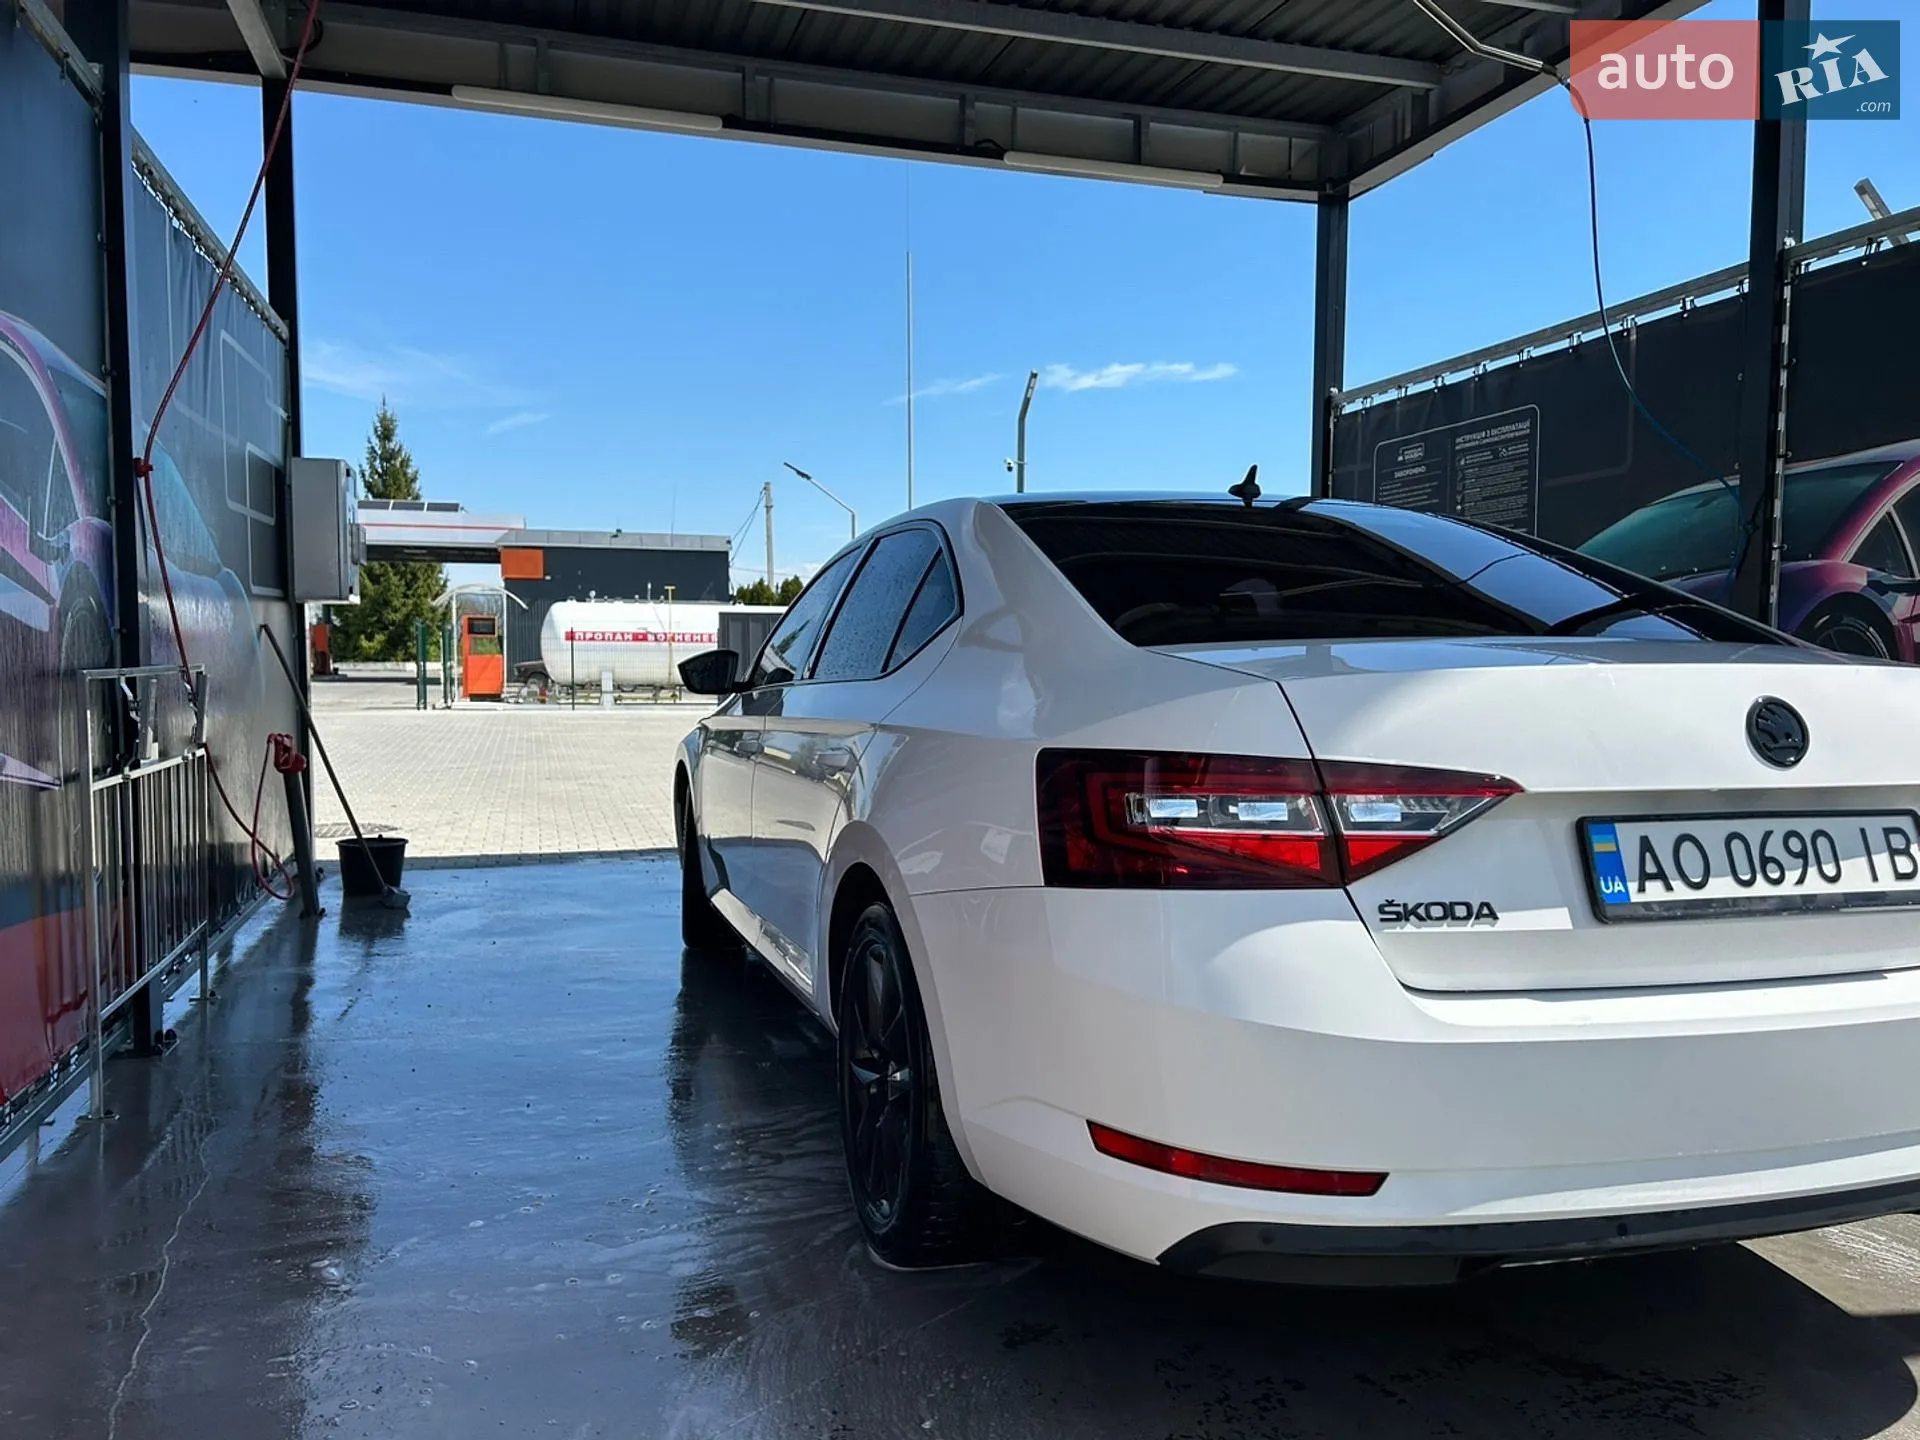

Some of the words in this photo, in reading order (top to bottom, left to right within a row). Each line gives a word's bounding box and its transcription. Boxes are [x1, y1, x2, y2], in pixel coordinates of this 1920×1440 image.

[575, 631, 633, 642] ПРОПАН
[1637, 832, 1711, 893] AO
[1724, 829, 1842, 887] 0690
[1859, 827, 1919, 882] IB
[1600, 875, 1626, 893] UA
[1378, 899, 1500, 922] ŠKODA
